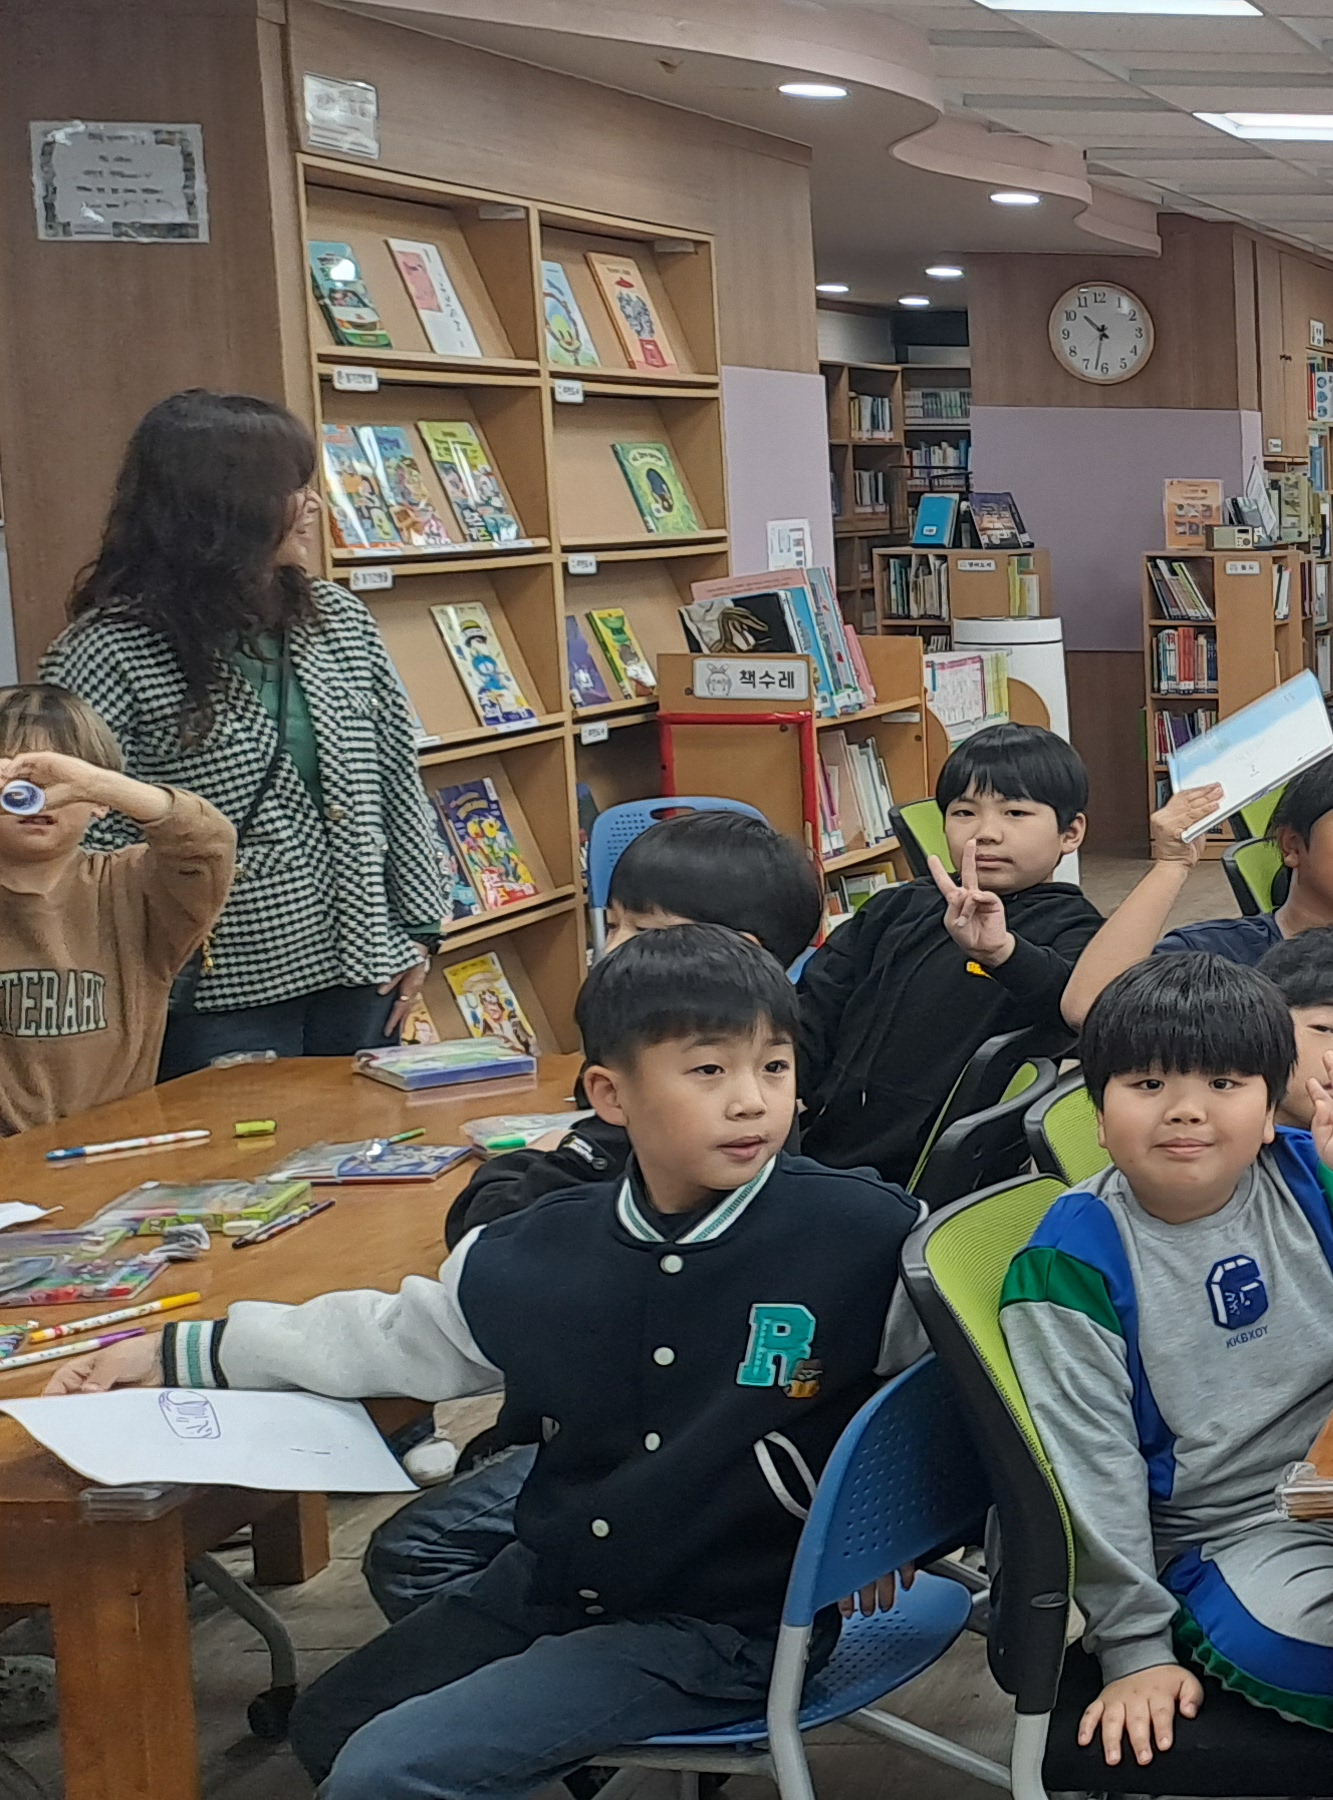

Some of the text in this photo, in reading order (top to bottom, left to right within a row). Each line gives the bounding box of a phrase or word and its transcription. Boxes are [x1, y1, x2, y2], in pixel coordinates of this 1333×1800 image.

[1077, 296, 1088, 308] 11
[1093, 291, 1106, 304] 12
[1065, 309, 1077, 321] 10
[1128, 309, 1137, 321] 2
[1062, 328, 1070, 340] 9
[1135, 327, 1143, 339] 3
[1068, 345, 1077, 357] 8
[1130, 345, 1138, 356] 4
[1082, 358, 1090, 370] 7
[1101, 363, 1109, 375] 6
[1119, 358, 1127, 370] 5
[739, 670, 794, 689] 책수레
[736, 1303, 816, 1388] R
